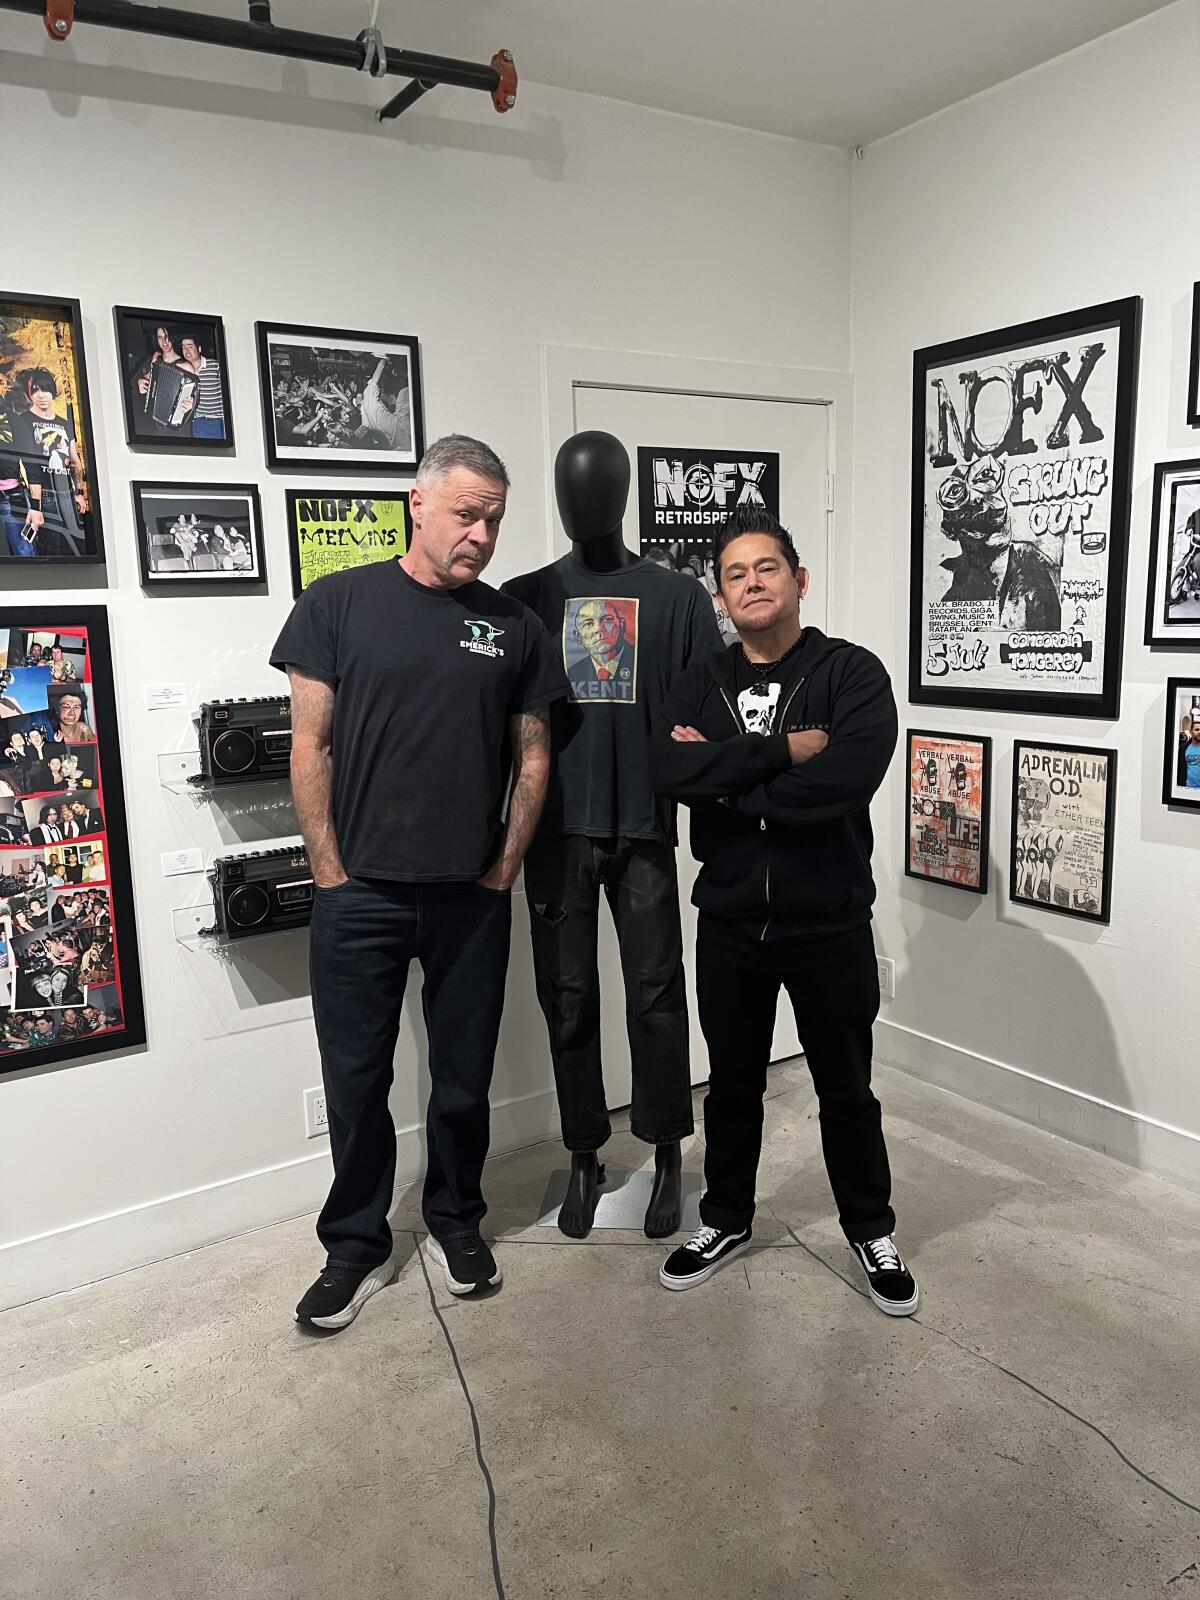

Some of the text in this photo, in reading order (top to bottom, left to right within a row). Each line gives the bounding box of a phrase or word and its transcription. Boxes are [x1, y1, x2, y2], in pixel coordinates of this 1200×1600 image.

[930, 342, 1106, 468] NOFX
[652, 457, 767, 509] NOFX
[1008, 456, 1108, 507] STRUNG
[299, 499, 378, 523] NOFX
[655, 510, 734, 525] RETROSPE
[1029, 500, 1093, 536] OUT
[300, 527, 398, 546] MELVINS
[460, 640, 505, 657] EMERICK'S
[926, 640, 949, 677] 5
[571, 680, 632, 699] KENT
[918, 750, 945, 761] VERBAL
[947, 753, 975, 764] VERBAL
[1021, 753, 1107, 784] ADRENALIN
[919, 785, 941, 795] ABUSE
[947, 789, 971, 800] ABUSE
[1049, 777, 1083, 798] O.D.
[946, 816, 980, 845] LIFE
